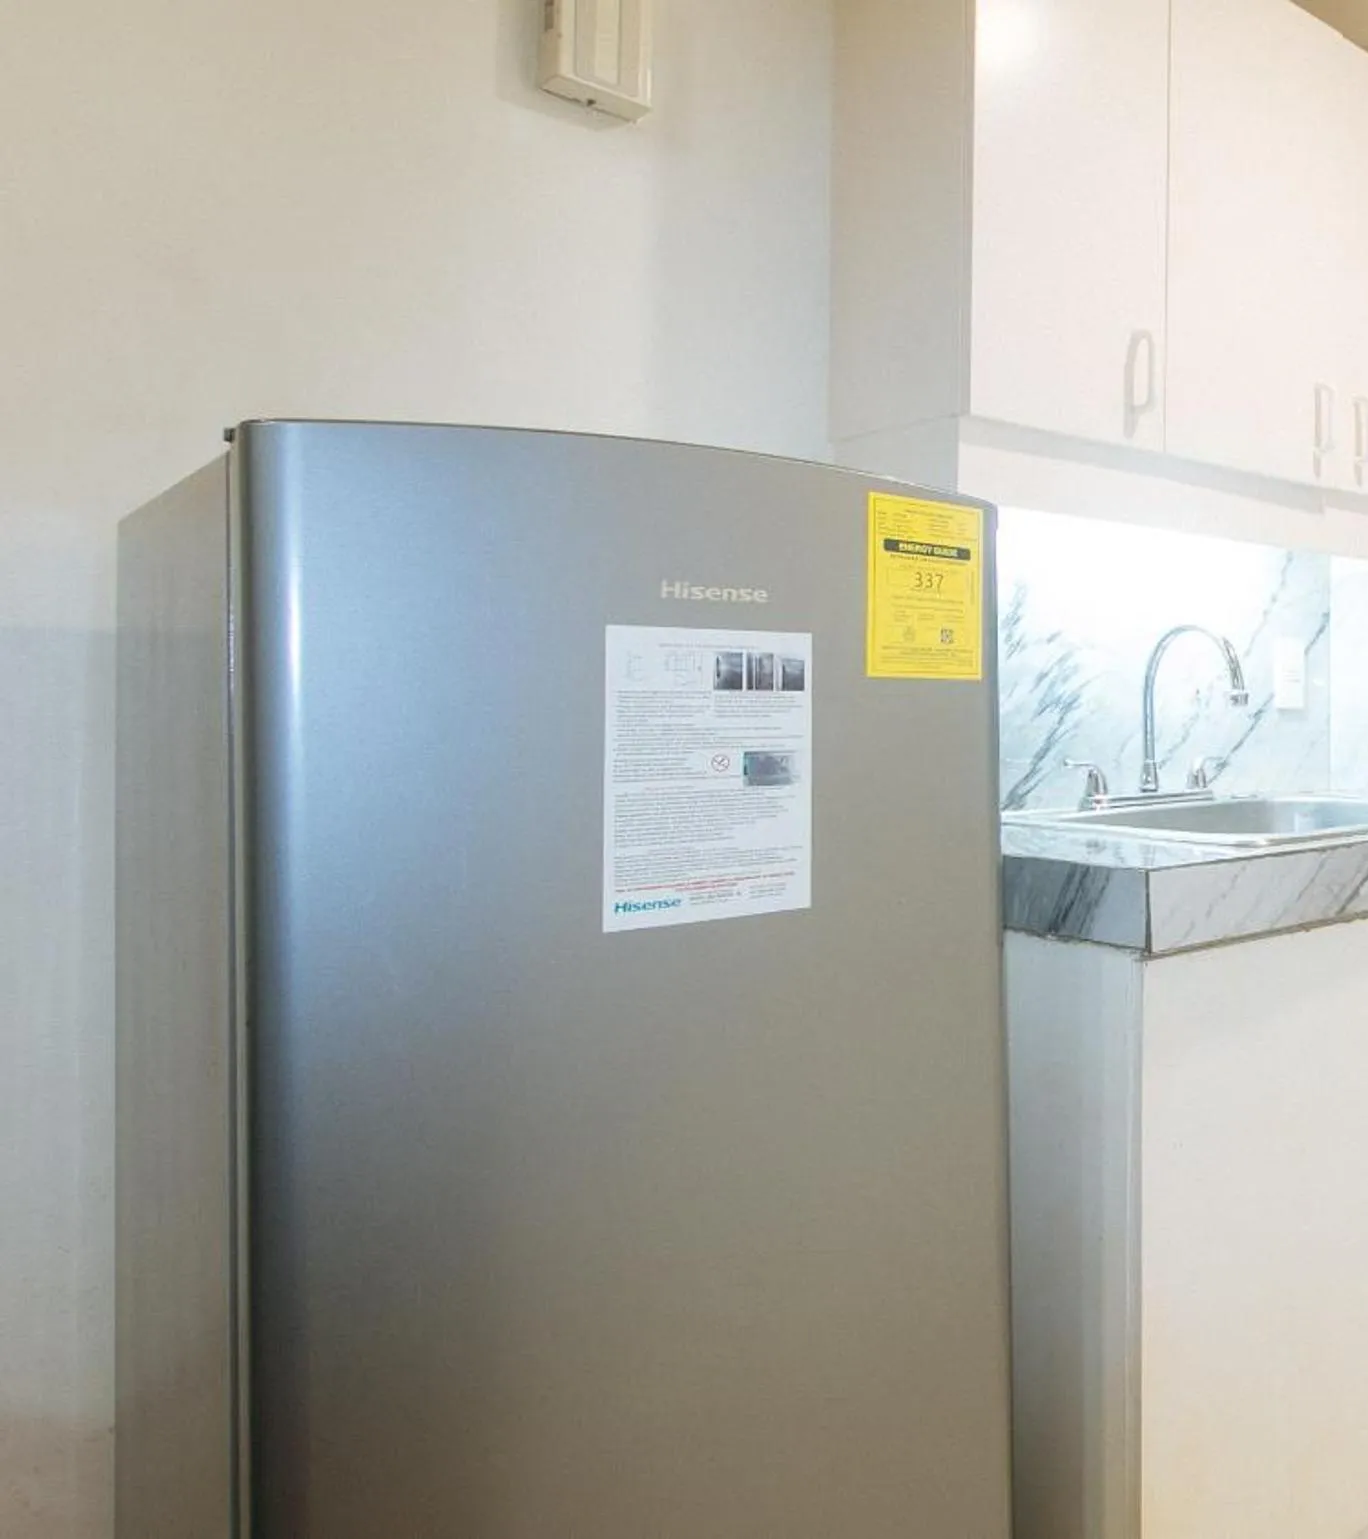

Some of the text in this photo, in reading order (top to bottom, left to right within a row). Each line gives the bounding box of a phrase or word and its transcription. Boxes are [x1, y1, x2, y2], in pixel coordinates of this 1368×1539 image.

[898, 542, 932, 555] ENERGY
[661, 581, 769, 604] Hisense
[914, 571, 944, 594] 337
[613, 897, 683, 915] Hisense
